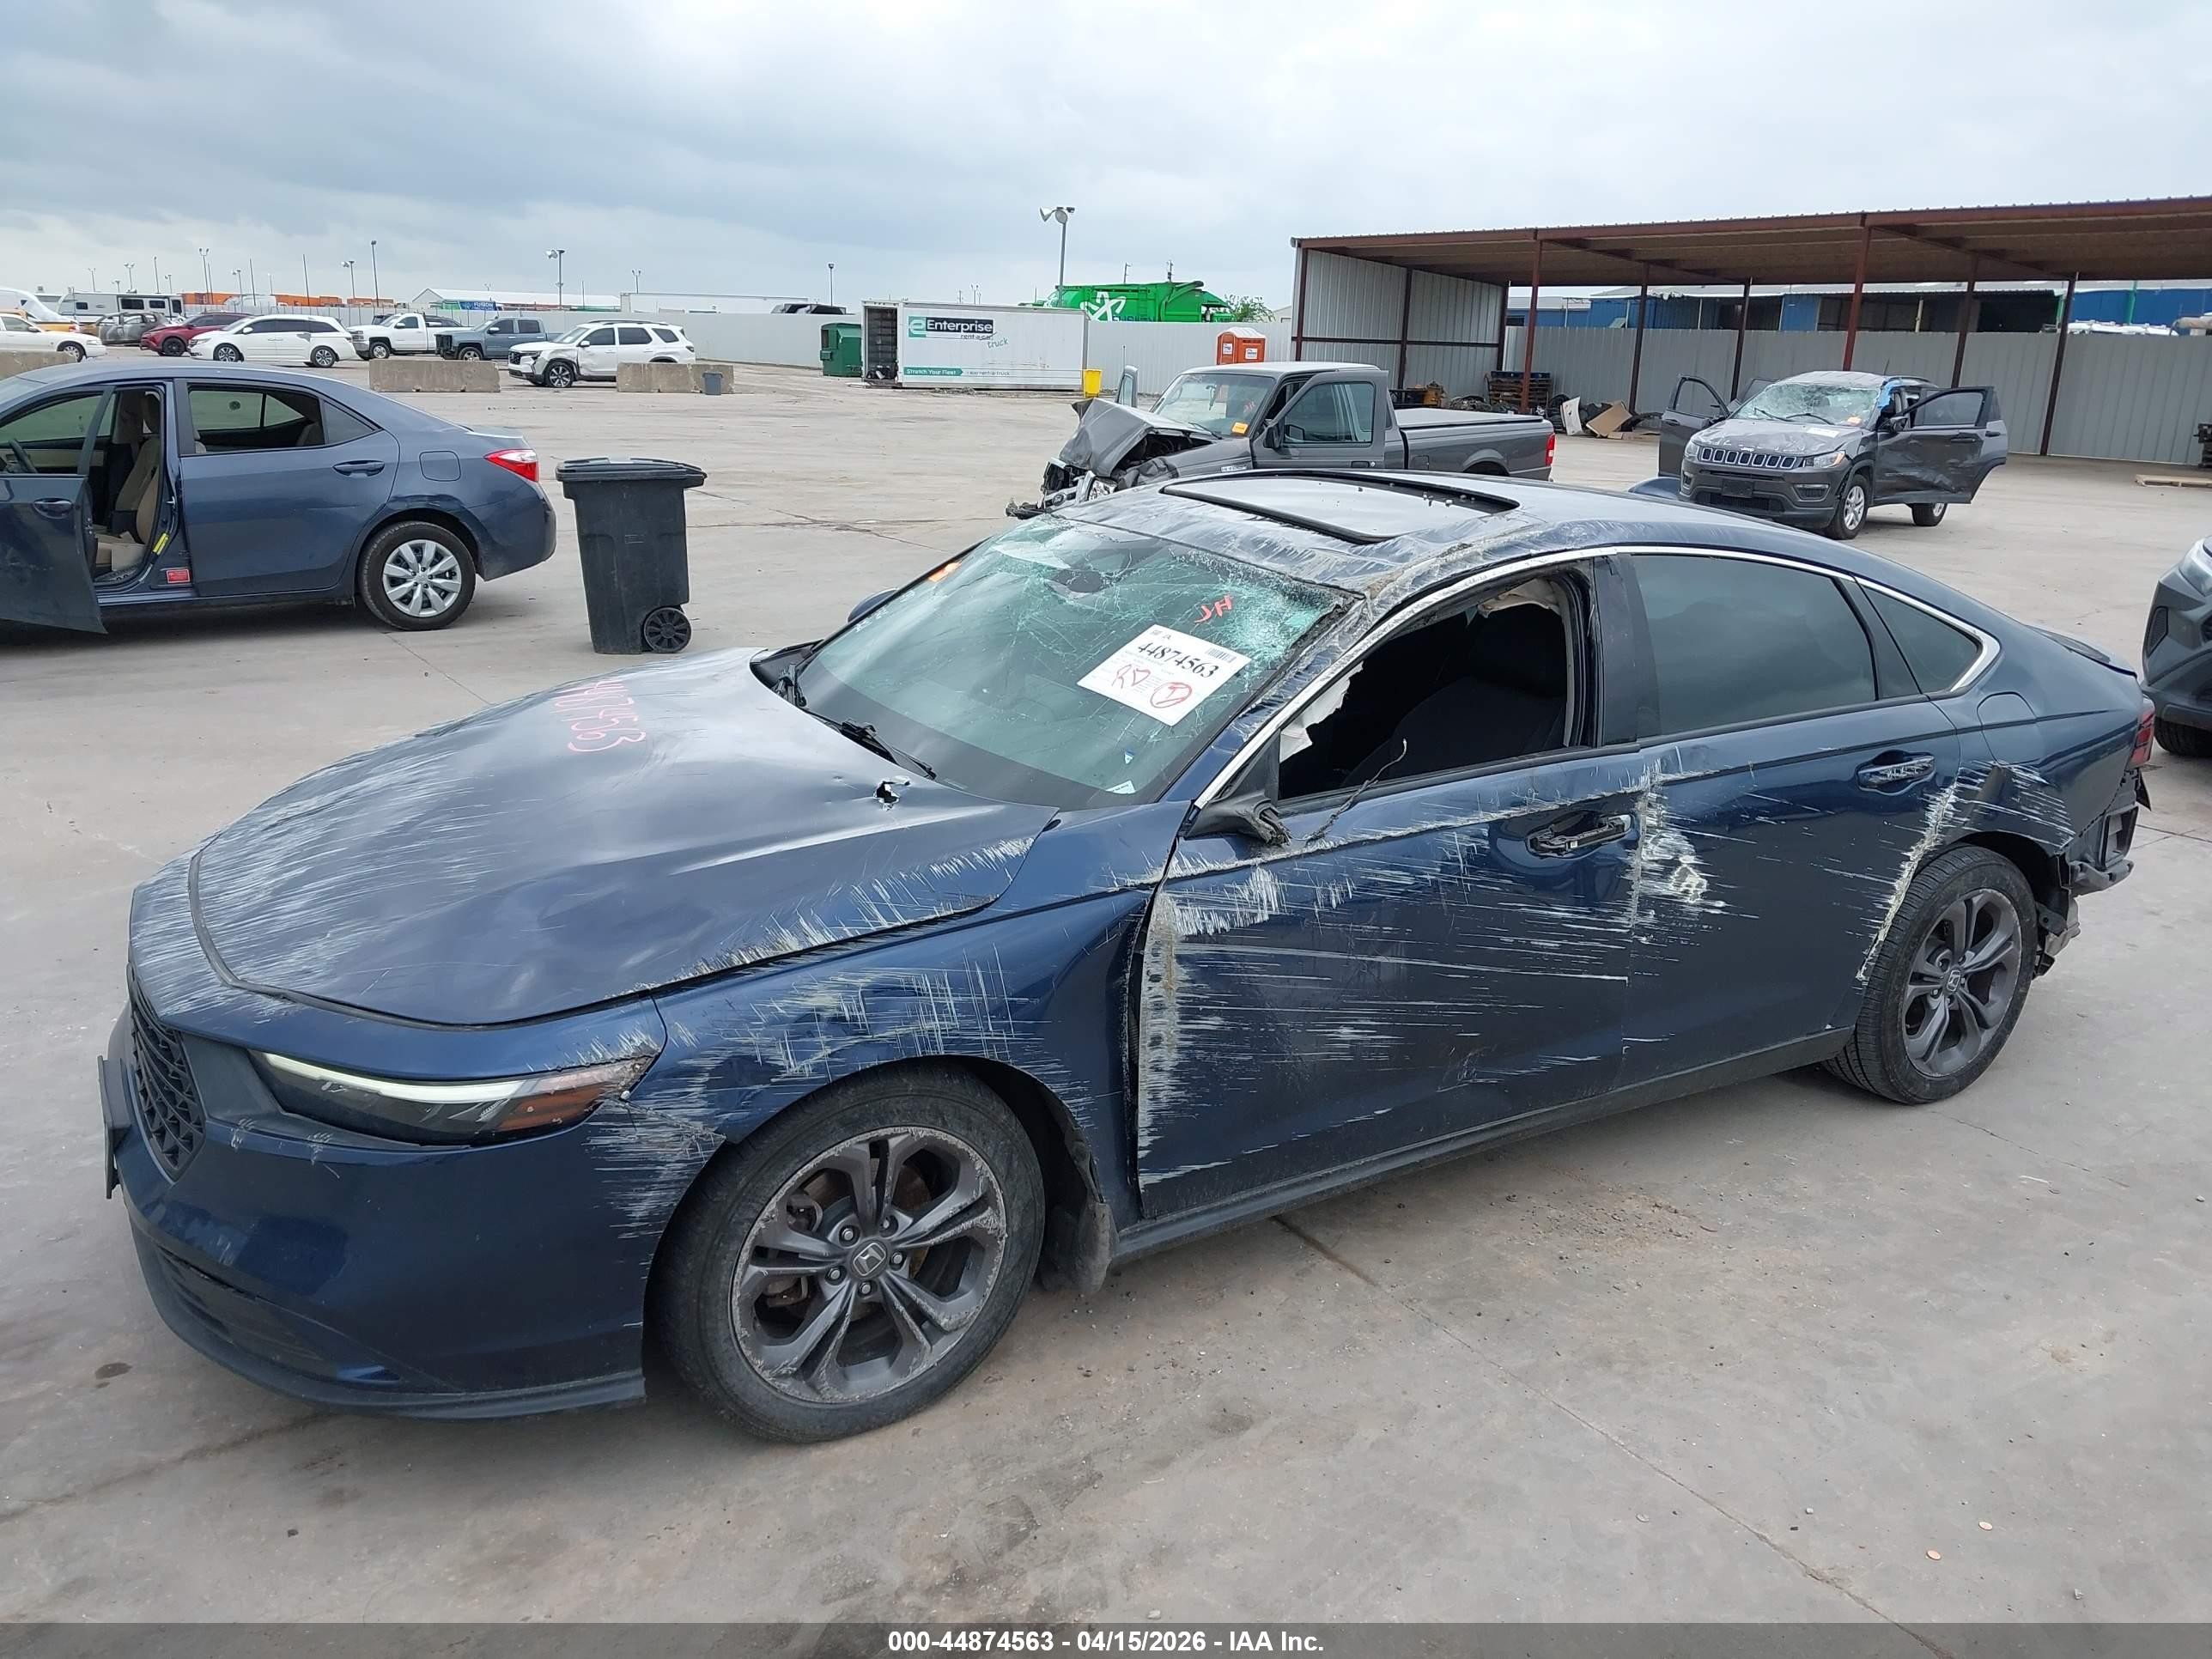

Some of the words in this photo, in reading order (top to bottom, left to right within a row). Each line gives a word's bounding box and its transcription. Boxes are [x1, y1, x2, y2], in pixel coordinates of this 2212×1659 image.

[927, 319, 993, 333] Enterprise
[988, 337, 1009, 349] truck
[1137, 641, 1219, 678] 44874563
